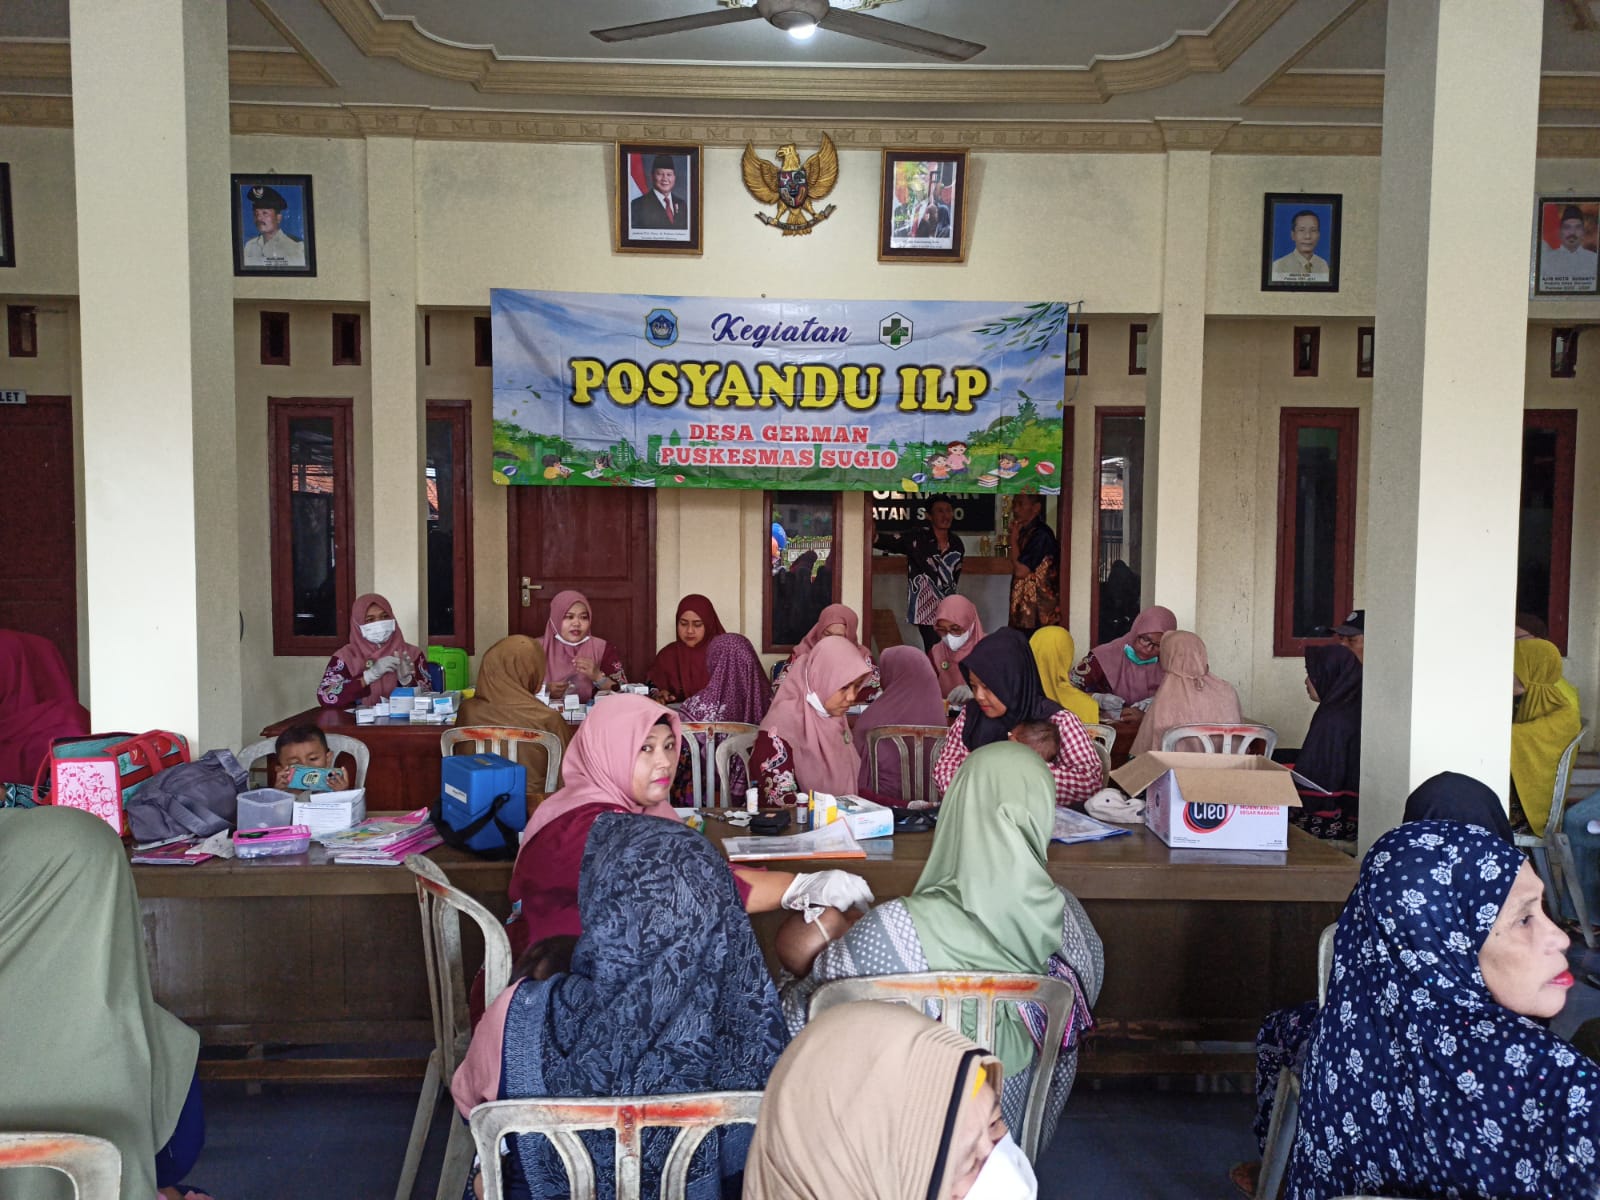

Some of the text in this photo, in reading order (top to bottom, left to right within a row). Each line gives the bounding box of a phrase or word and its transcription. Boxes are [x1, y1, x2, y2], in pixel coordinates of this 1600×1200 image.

[711, 313, 852, 348] Kegiatan
[570, 359, 989, 412] POSYANDU ILP
[689, 424, 869, 443] DESA GERMAN
[660, 447, 897, 468] PUSKESMAS SUGIO
[1193, 802, 1225, 820] Cleo
